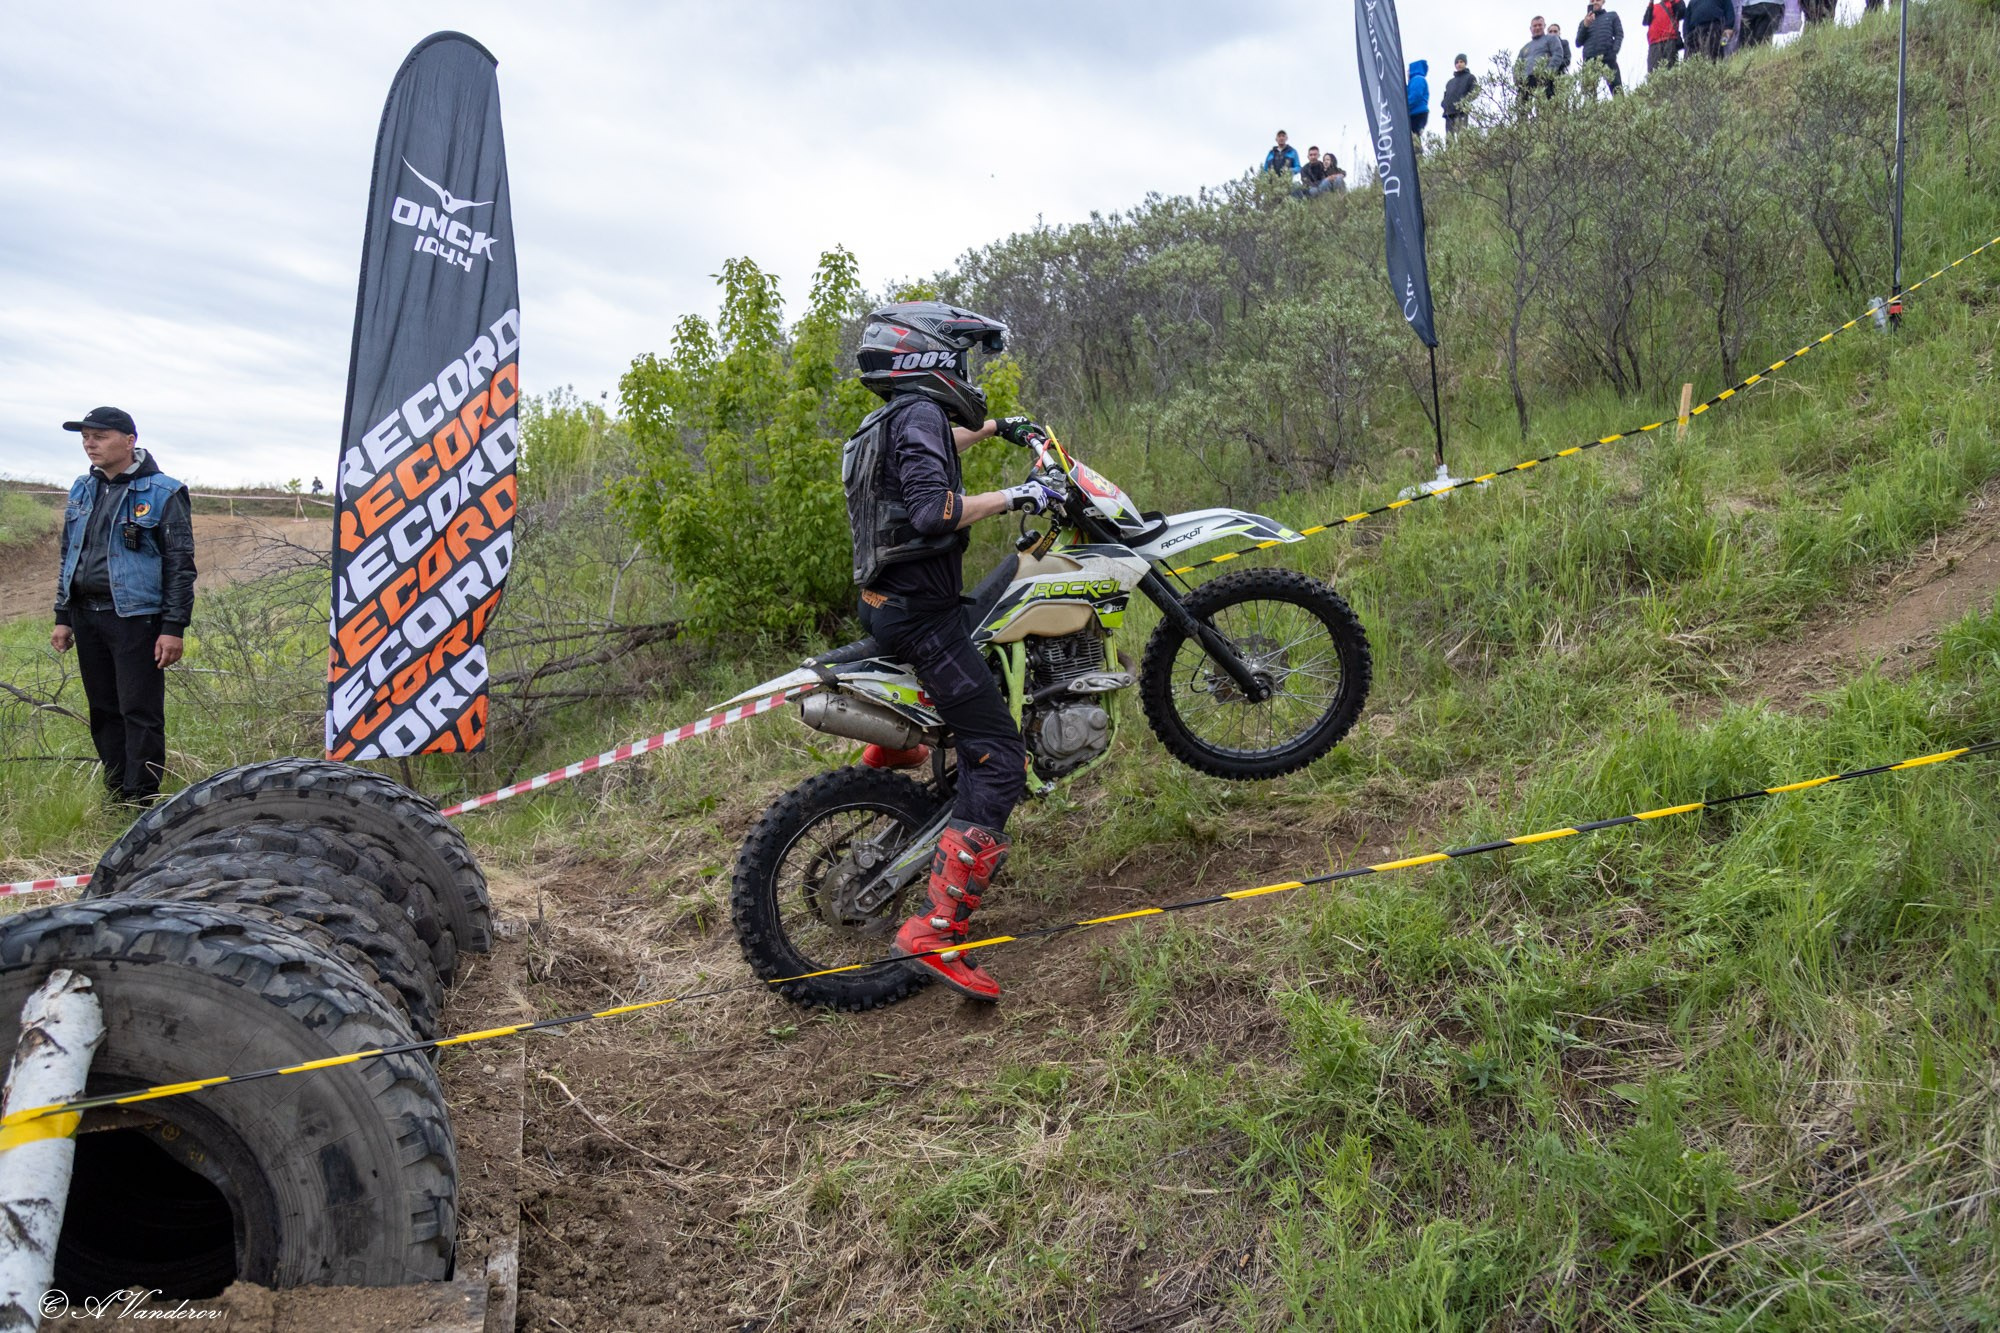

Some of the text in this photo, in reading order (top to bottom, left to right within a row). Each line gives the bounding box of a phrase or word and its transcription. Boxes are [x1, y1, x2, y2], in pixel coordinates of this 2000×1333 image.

[892, 351, 957, 370] 100%
[339, 308, 520, 502] RECORD
[1160, 526, 1204, 549] ROCKOT
